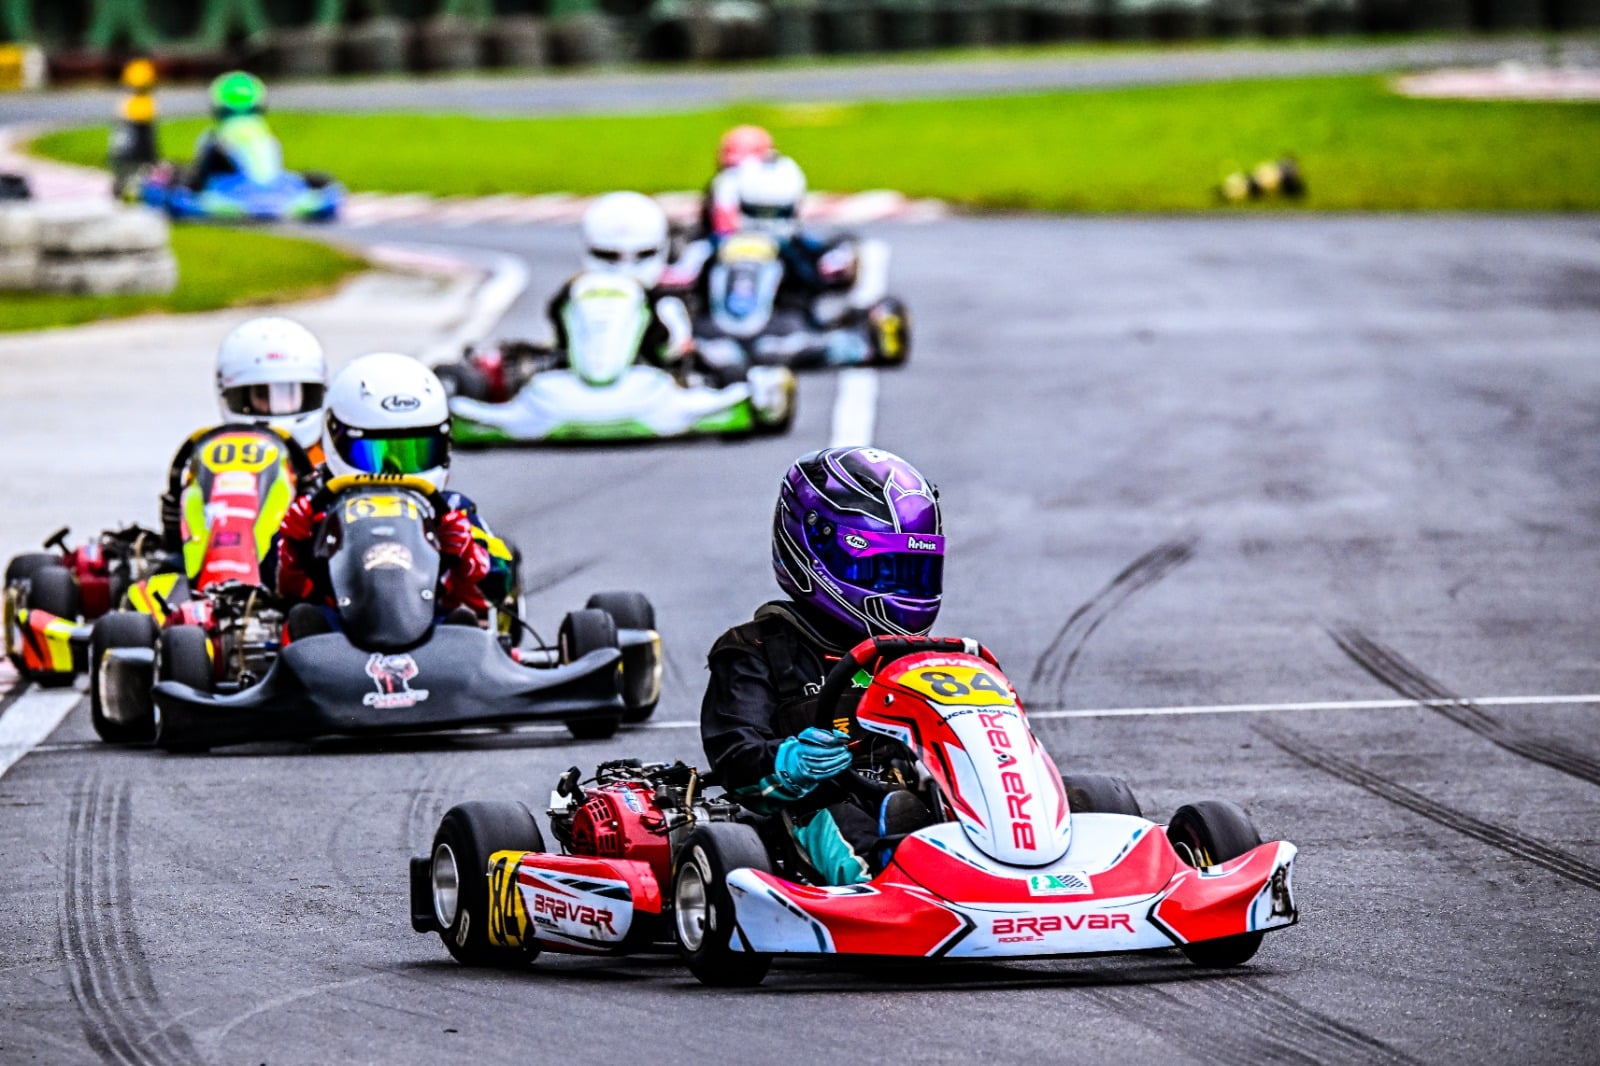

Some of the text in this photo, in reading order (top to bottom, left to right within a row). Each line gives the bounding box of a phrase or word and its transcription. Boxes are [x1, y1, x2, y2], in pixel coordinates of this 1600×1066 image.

[212, 443, 265, 464] 09
[920, 672, 1008, 698] 84
[978, 712, 1037, 851] BRAVAR
[492, 856, 522, 945] 84
[992, 913, 1136, 937] BRAVAR
